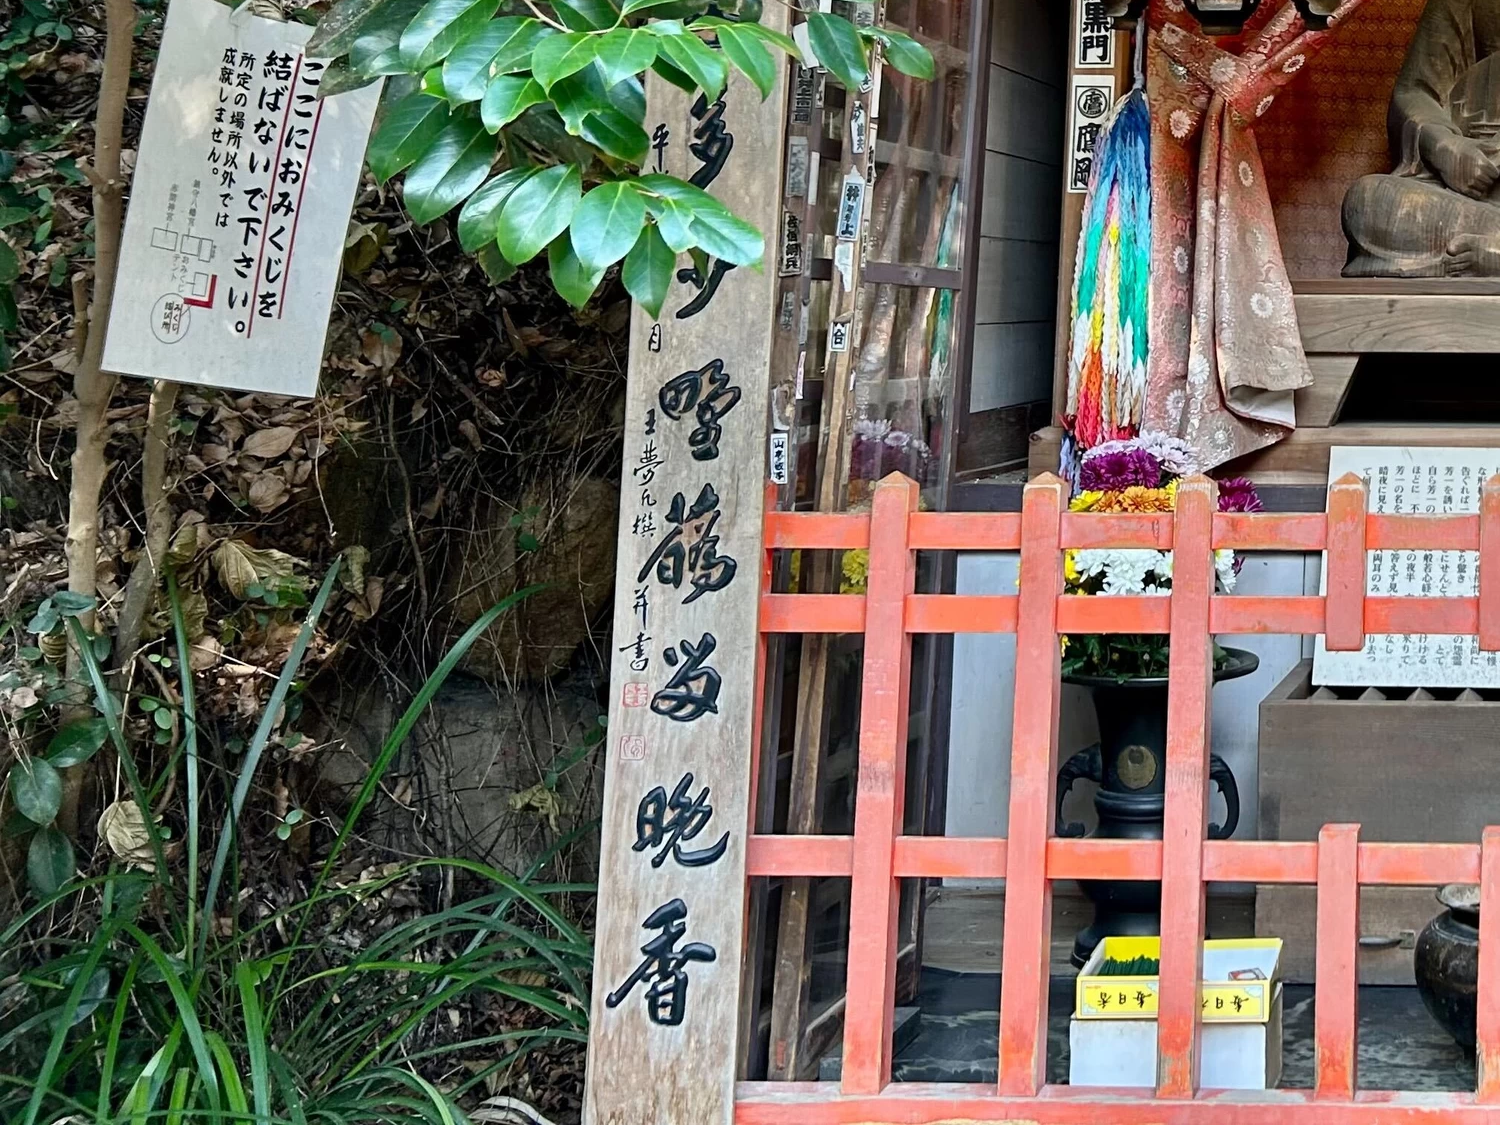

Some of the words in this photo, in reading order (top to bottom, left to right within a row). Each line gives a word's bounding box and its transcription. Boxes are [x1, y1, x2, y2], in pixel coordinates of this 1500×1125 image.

[206, 47, 237, 178] 成就しません。
[214, 51, 257, 229] 所定の場所以外では
[257, 59, 325, 320] ここにおみくじを
[226, 49, 292, 336] 結ばないで下さい。
[1393, 465, 1406, 514] 芳一の名を
[1425, 465, 1438, 514] 自ら芳一の
